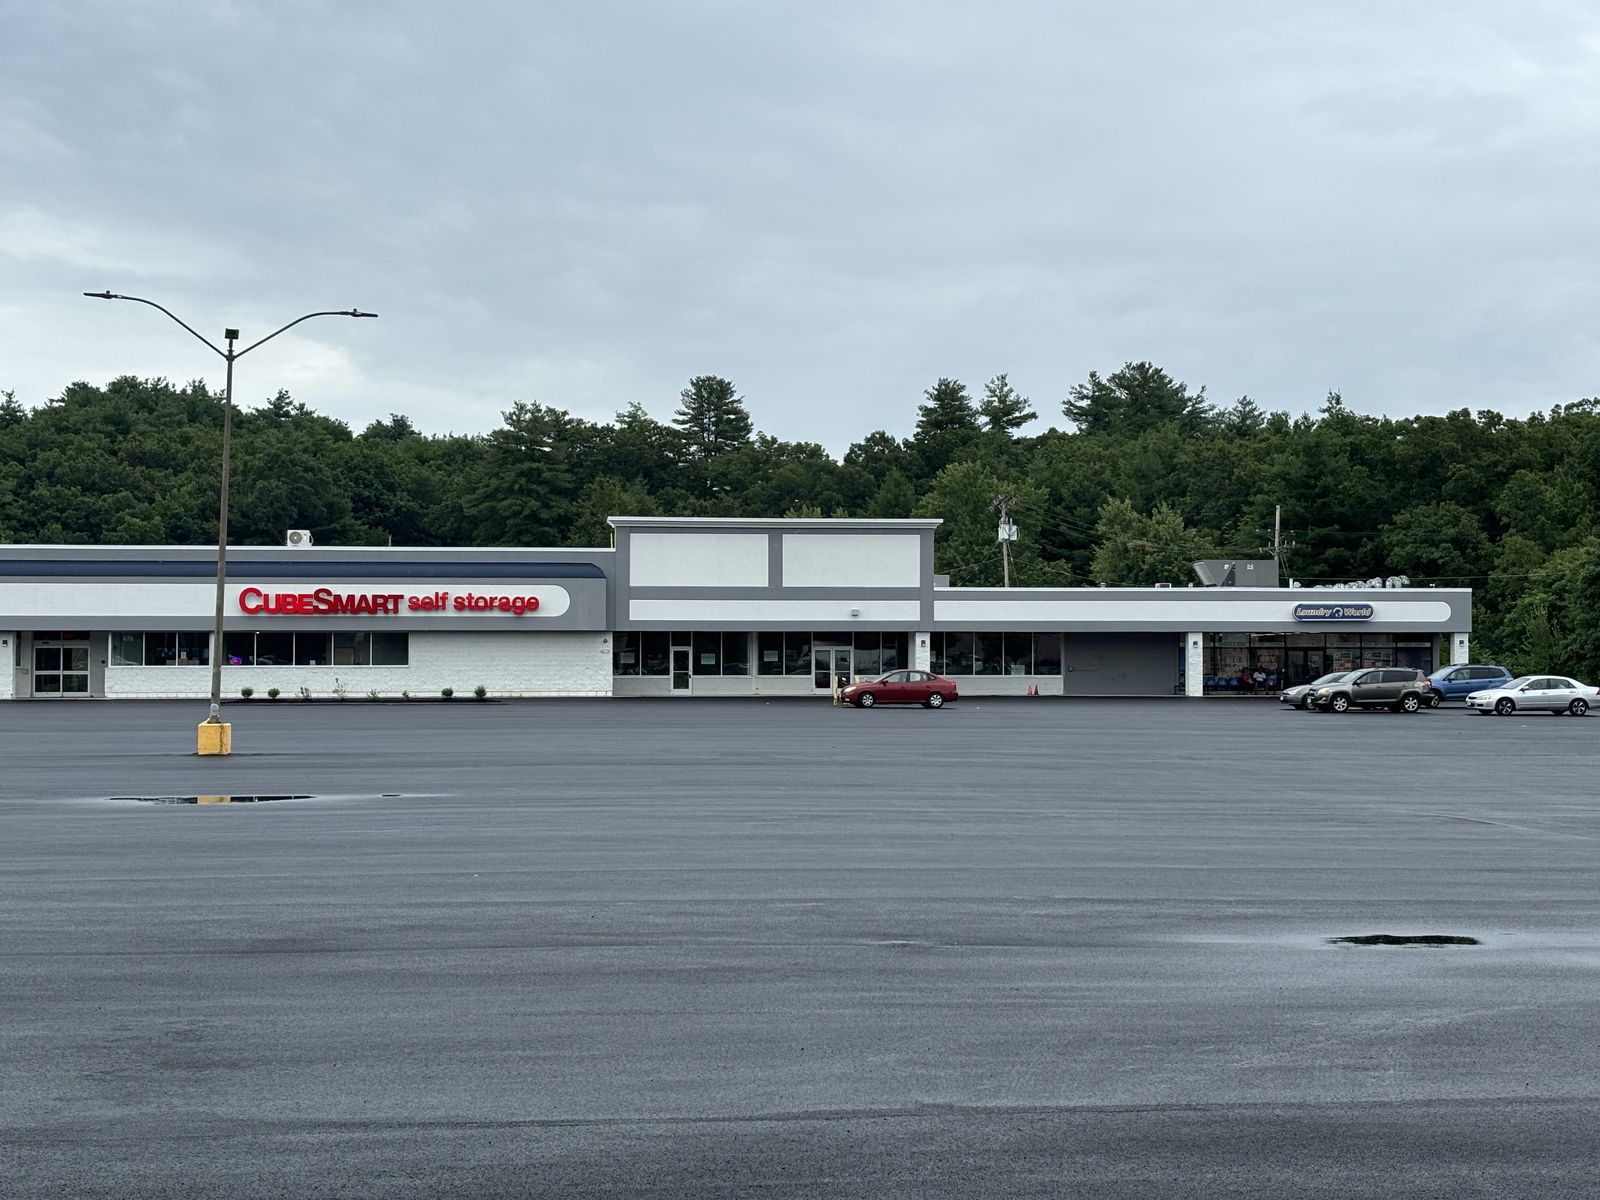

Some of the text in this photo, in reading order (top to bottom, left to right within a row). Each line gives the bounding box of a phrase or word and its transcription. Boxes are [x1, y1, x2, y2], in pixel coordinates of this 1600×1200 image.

[408, 591, 448, 610] self
[453, 593, 540, 615] storage
[1296, 607, 1371, 617] Laundry World
